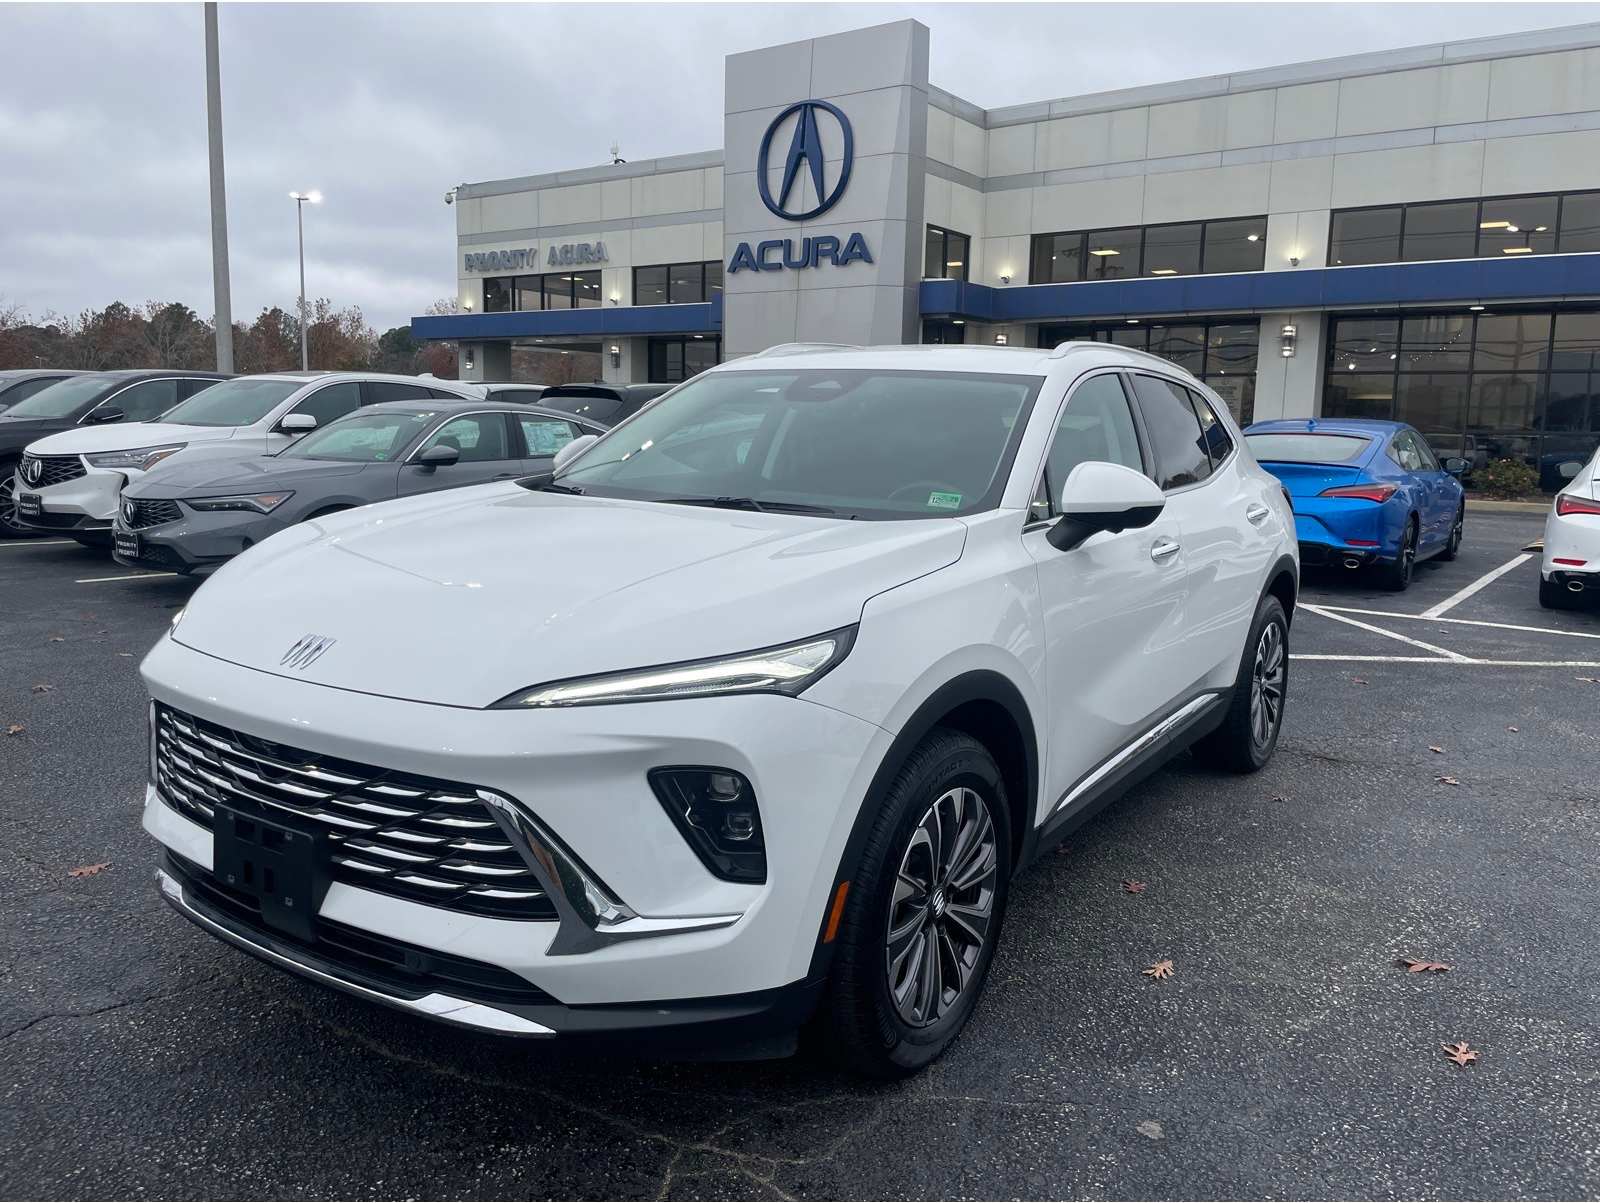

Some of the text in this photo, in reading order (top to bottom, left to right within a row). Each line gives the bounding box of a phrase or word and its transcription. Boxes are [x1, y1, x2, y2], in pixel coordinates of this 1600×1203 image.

[464, 241, 609, 273] PRIORITY ACURA
[727, 232, 874, 273] ACURA
